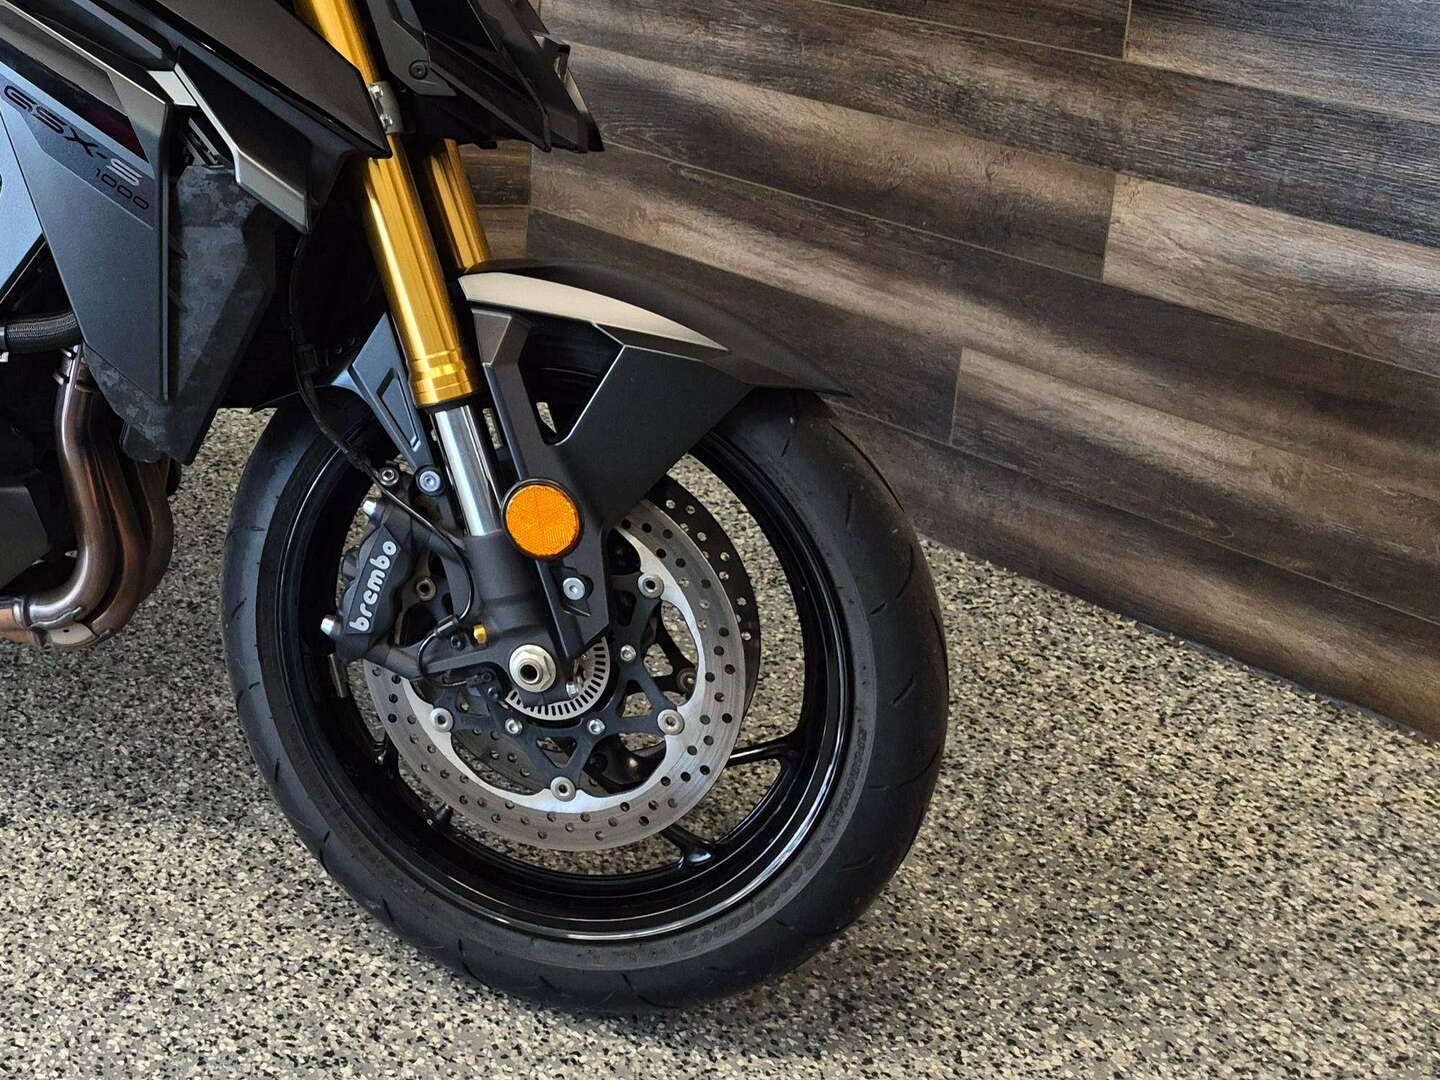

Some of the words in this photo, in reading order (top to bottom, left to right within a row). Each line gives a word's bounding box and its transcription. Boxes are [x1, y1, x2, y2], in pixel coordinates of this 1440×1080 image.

[4, 85, 143, 187] GSX-S
[96, 168, 149, 210] 1000
[349, 541, 397, 632] brembo
